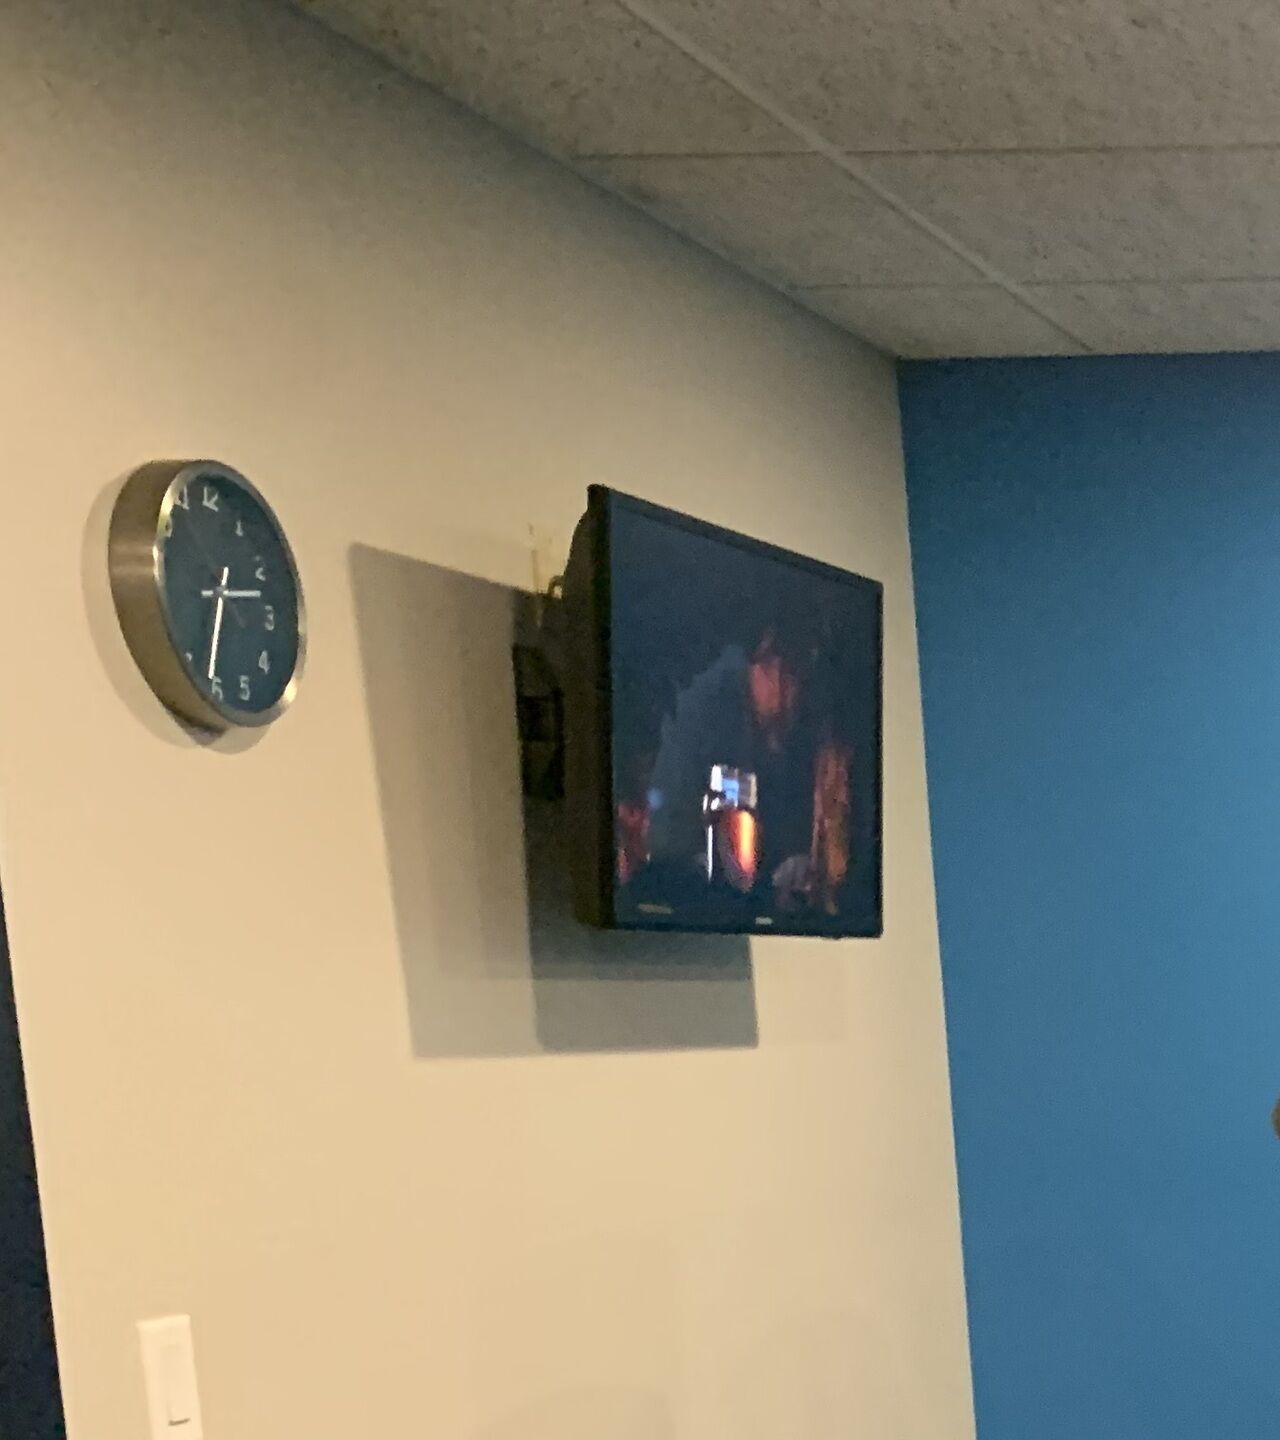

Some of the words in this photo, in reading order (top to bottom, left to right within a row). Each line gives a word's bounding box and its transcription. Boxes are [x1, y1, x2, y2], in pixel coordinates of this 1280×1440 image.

[264, 604, 276, 632] 3
[258, 650, 271, 675] 4
[239, 674, 251, 701] 5
